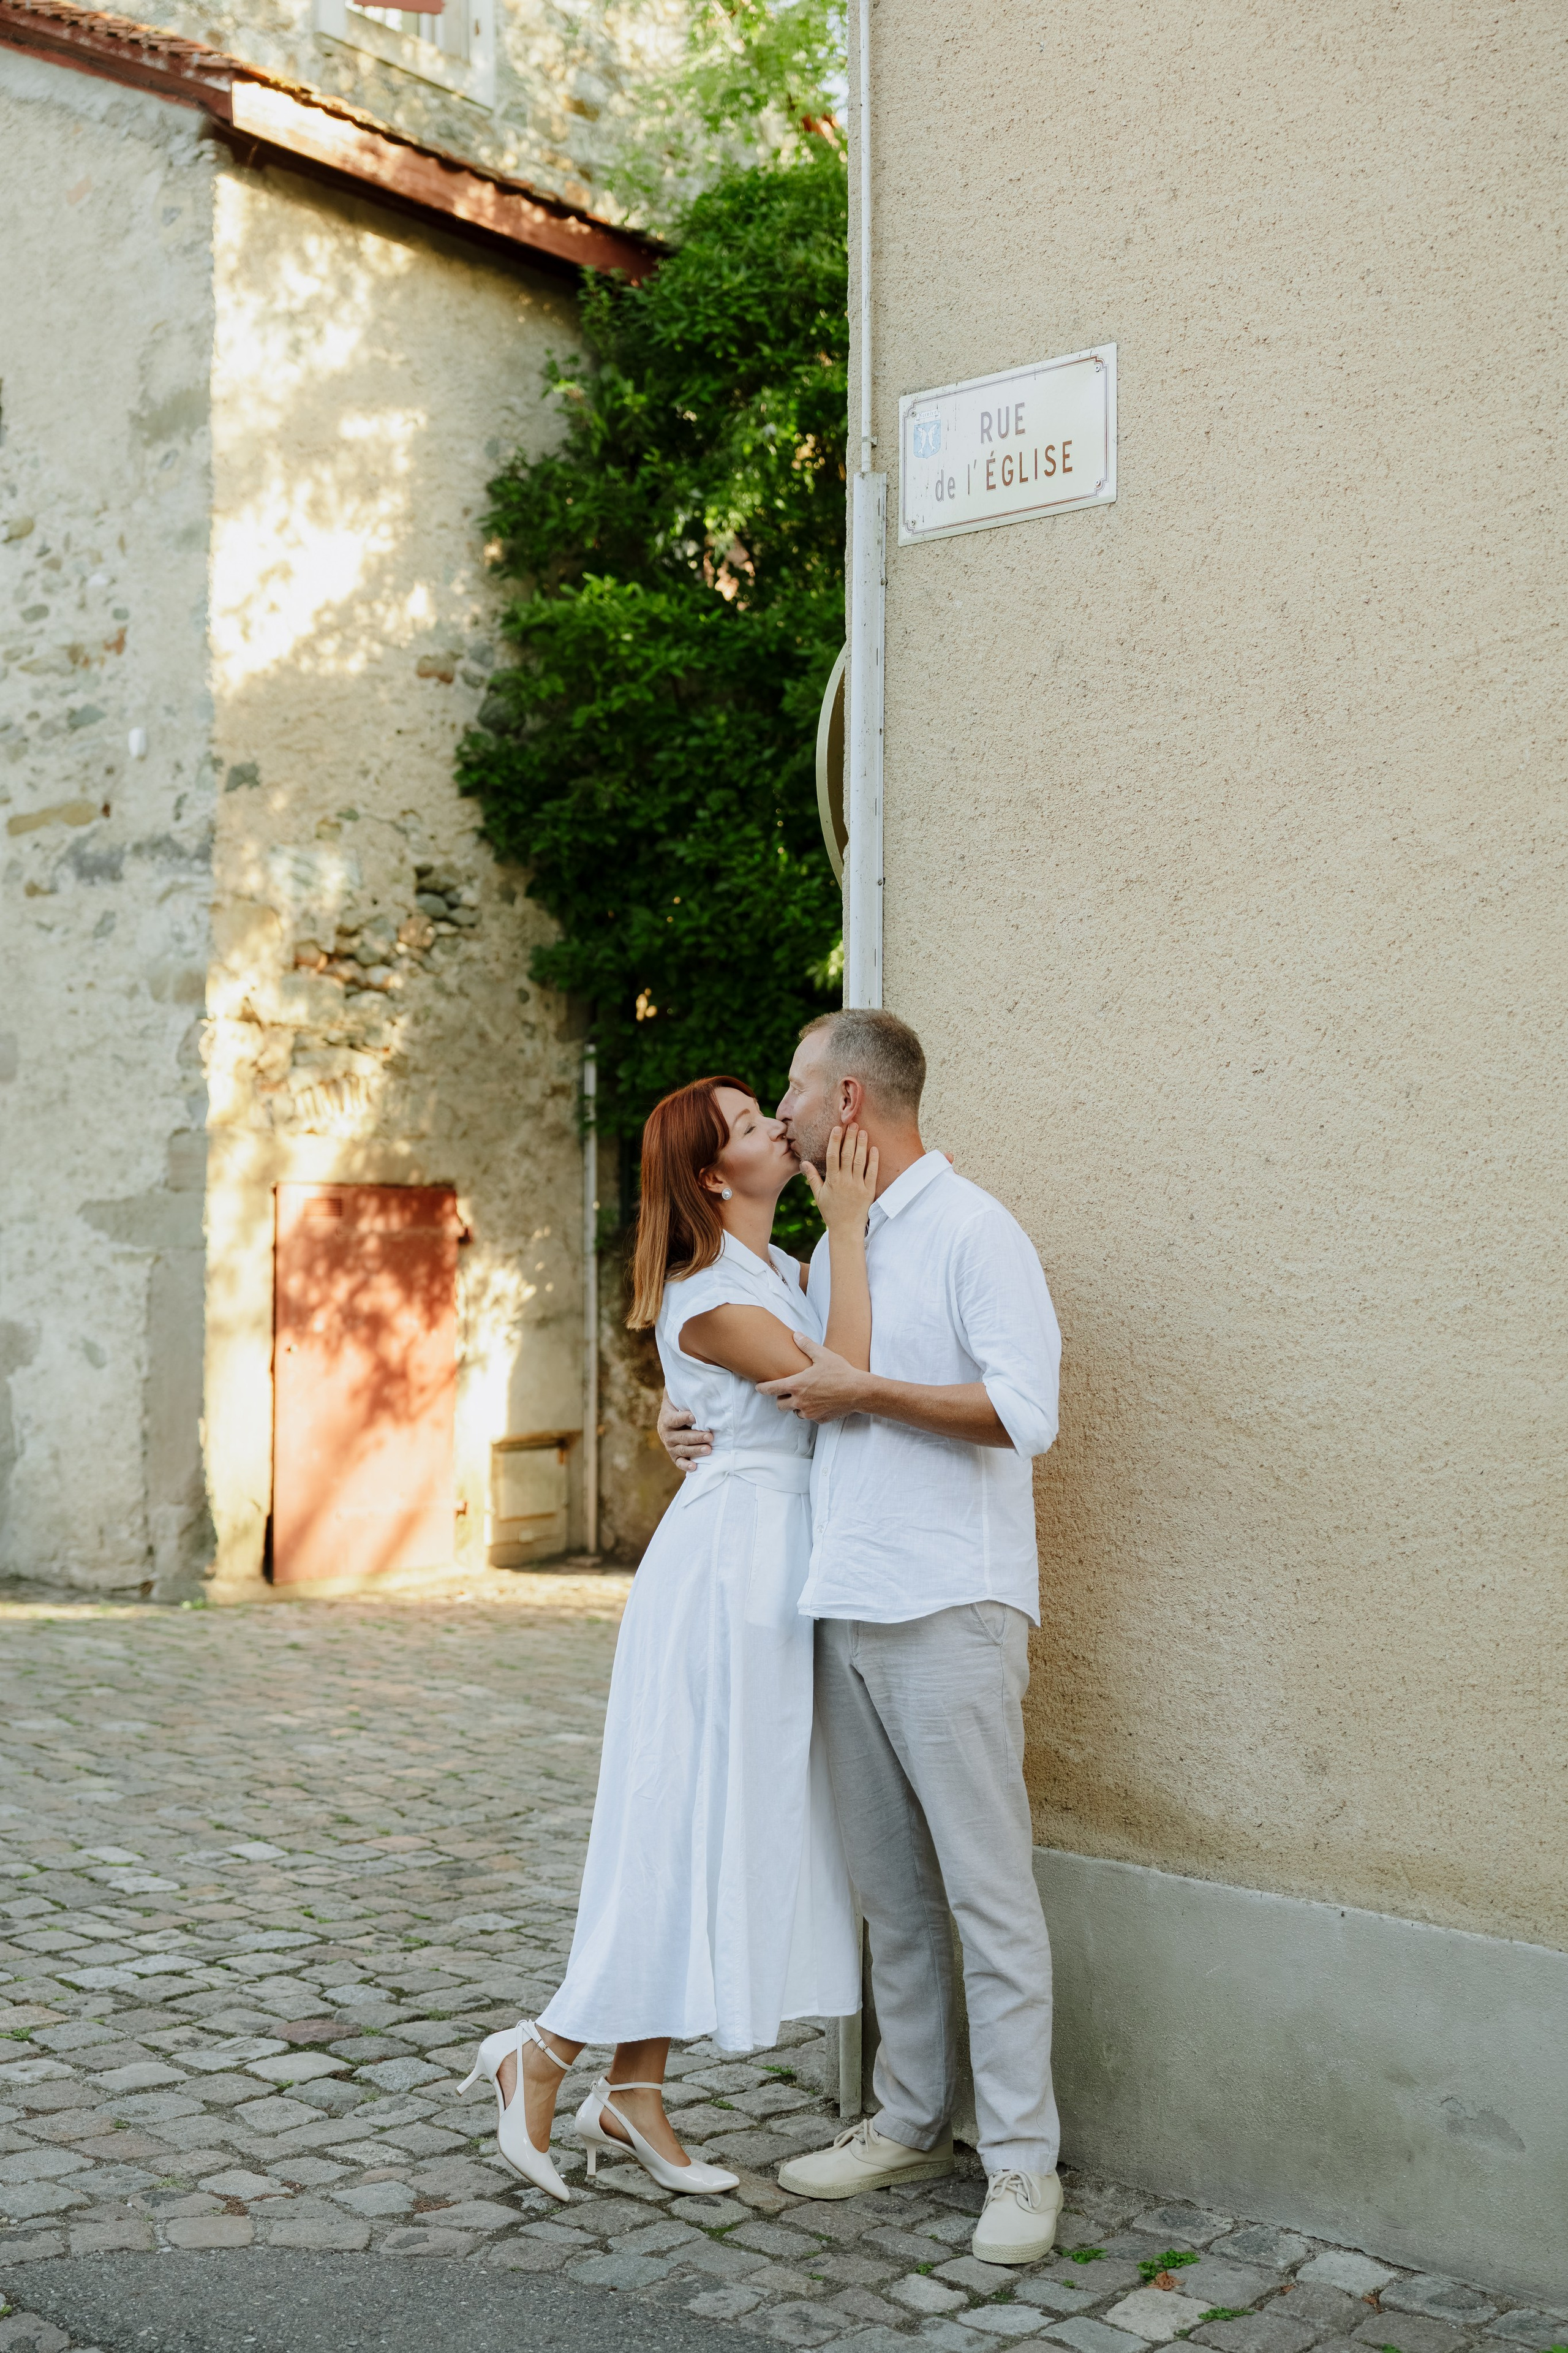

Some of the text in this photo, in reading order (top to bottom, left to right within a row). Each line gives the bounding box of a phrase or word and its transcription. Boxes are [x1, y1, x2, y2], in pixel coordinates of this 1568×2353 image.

[980, 402, 1026, 445] RUE
[935, 440, 1074, 502] de l'ÉGLISE
